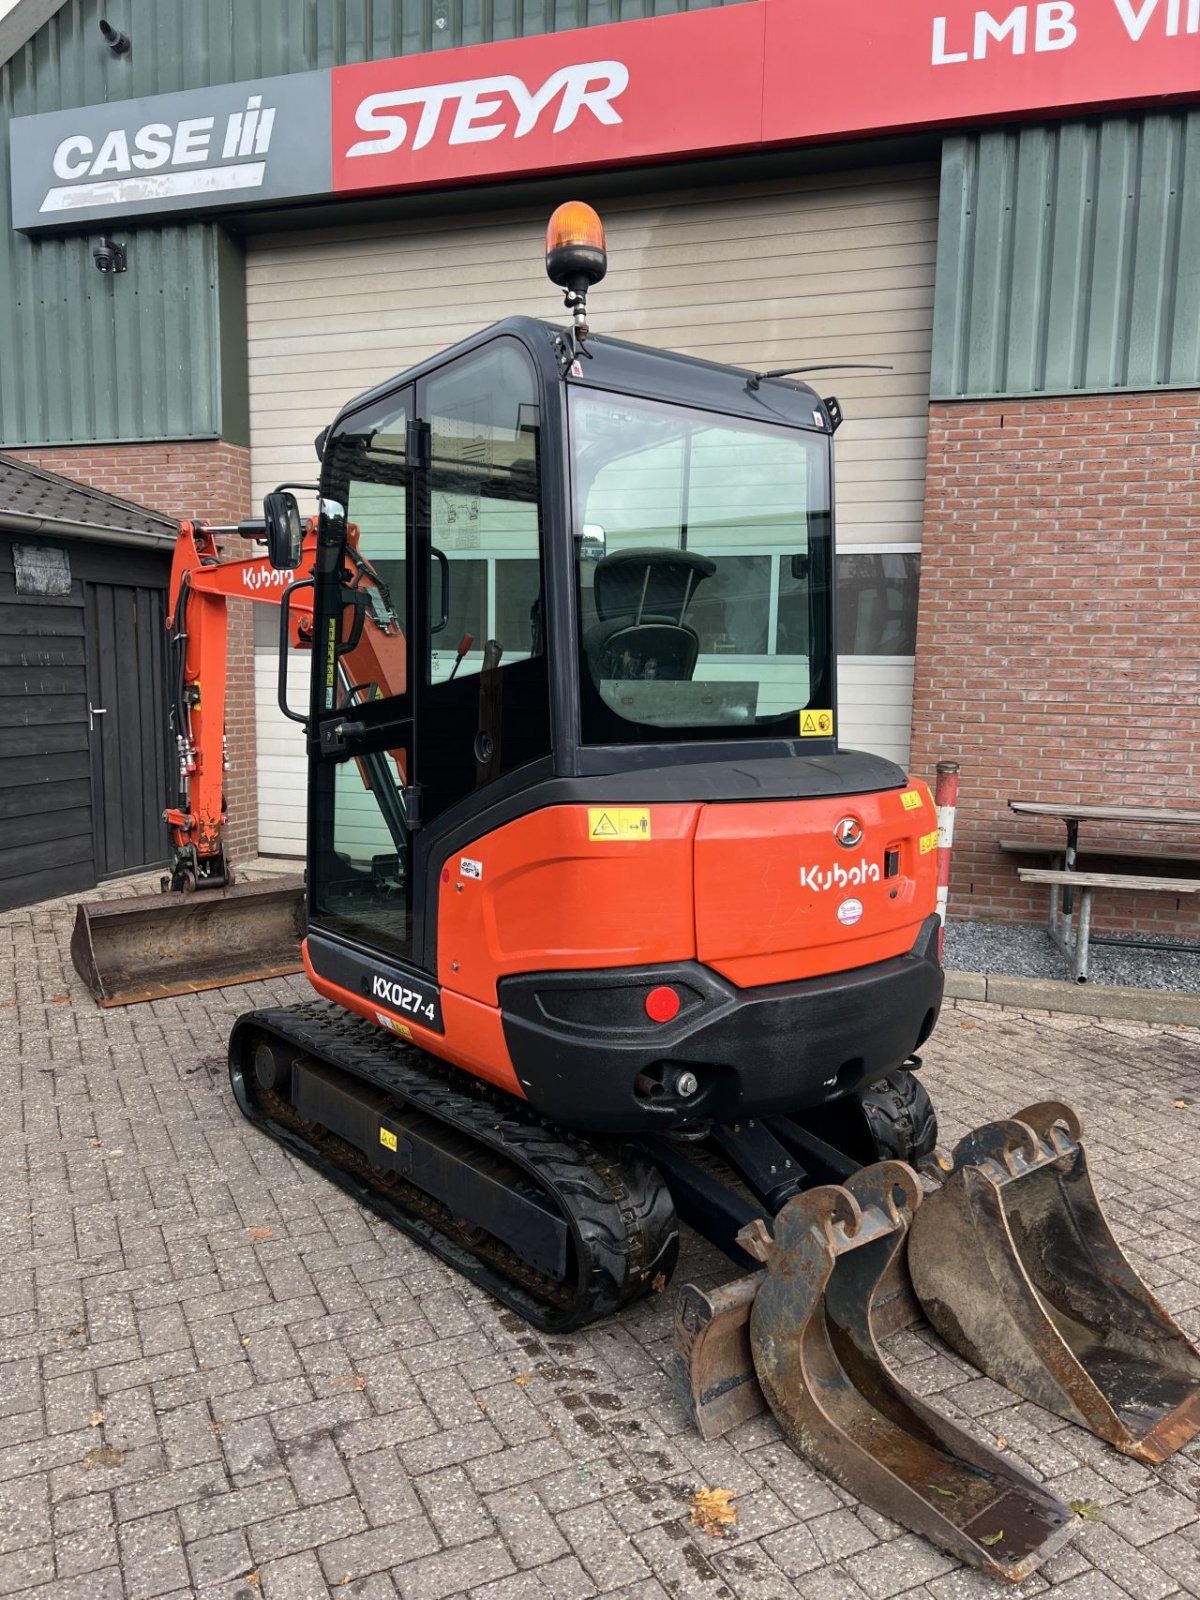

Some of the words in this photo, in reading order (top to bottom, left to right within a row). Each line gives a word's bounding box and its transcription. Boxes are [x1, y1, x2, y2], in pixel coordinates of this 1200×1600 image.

[931, 0, 1078, 66] LMB
[345, 60, 630, 158] STEYR
[52, 117, 215, 180] CASE
[242, 565, 295, 590] Kubota
[800, 858, 880, 891] Kubota
[372, 975, 435, 1021] KX027-4
